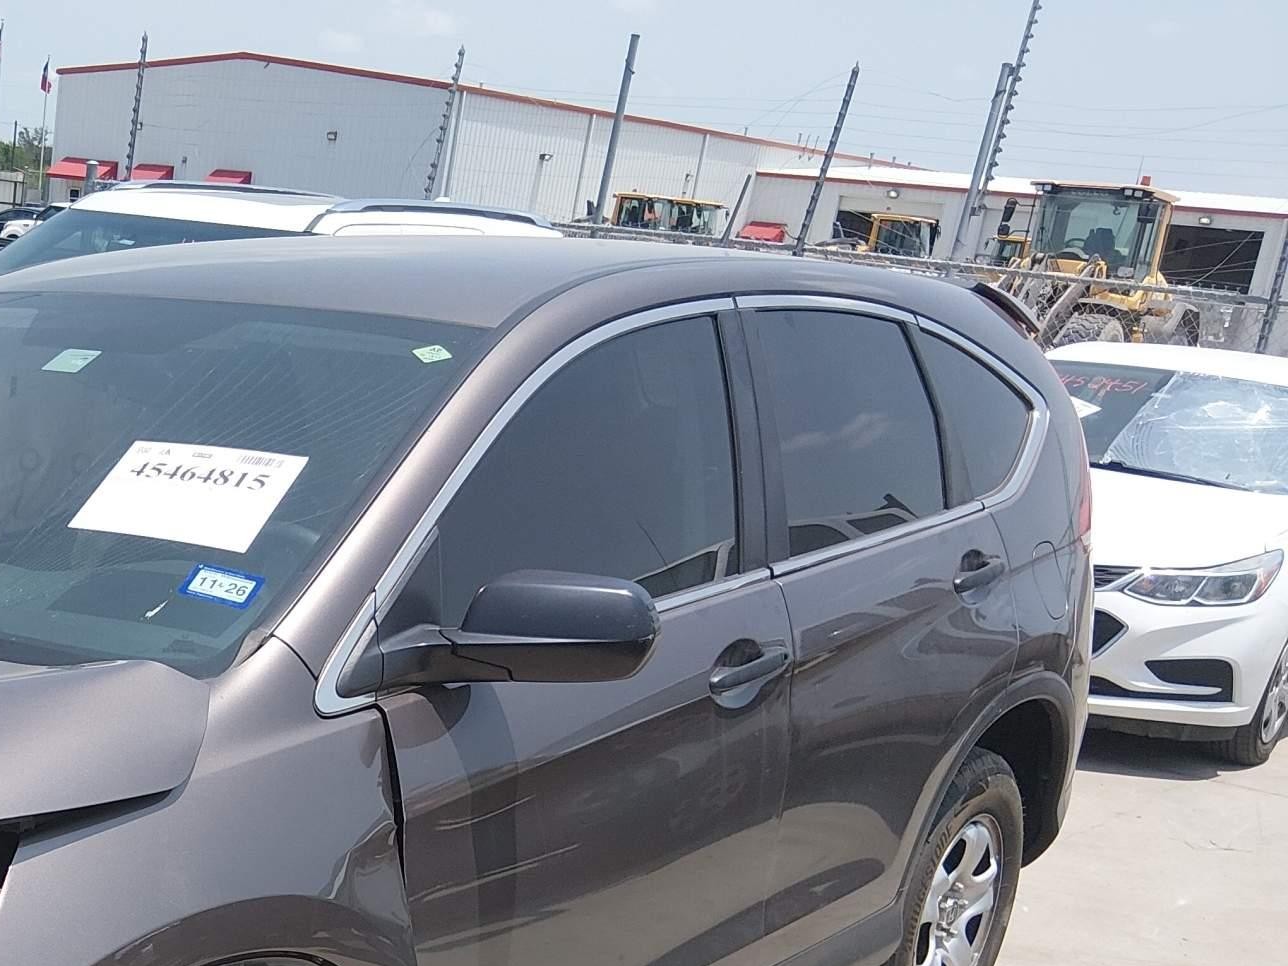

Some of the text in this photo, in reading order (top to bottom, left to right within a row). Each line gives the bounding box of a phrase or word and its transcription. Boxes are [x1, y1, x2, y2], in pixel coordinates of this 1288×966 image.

[130, 461, 271, 491] 45464815
[199, 576, 219, 590] 11
[224, 582, 249, 597] 26
